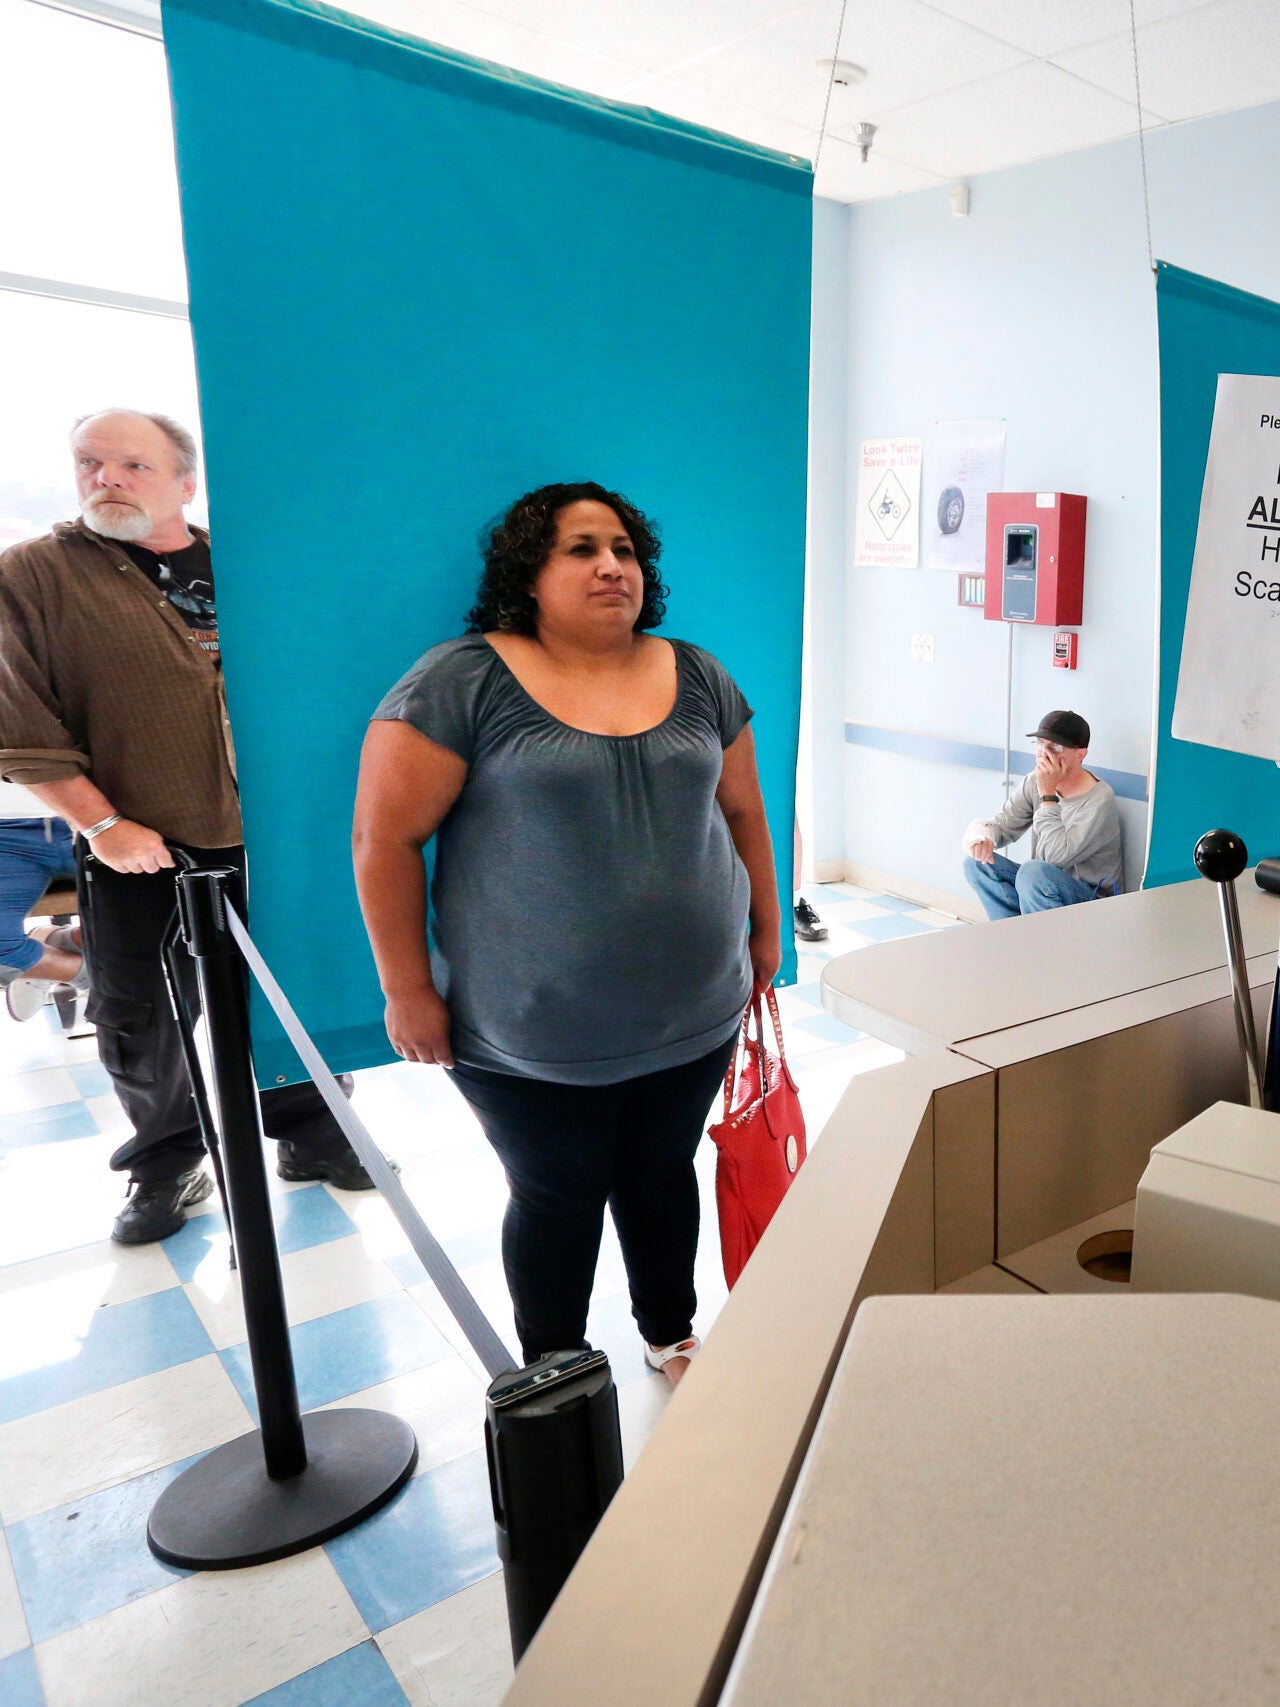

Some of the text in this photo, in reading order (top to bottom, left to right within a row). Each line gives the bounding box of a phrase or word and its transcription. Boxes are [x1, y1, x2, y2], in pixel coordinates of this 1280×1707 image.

[863, 443, 920, 455] Look Twice
[863, 456, 887, 467] Save
[900, 454, 919, 467] Life
[1054, 633, 1070, 643] FIRE
